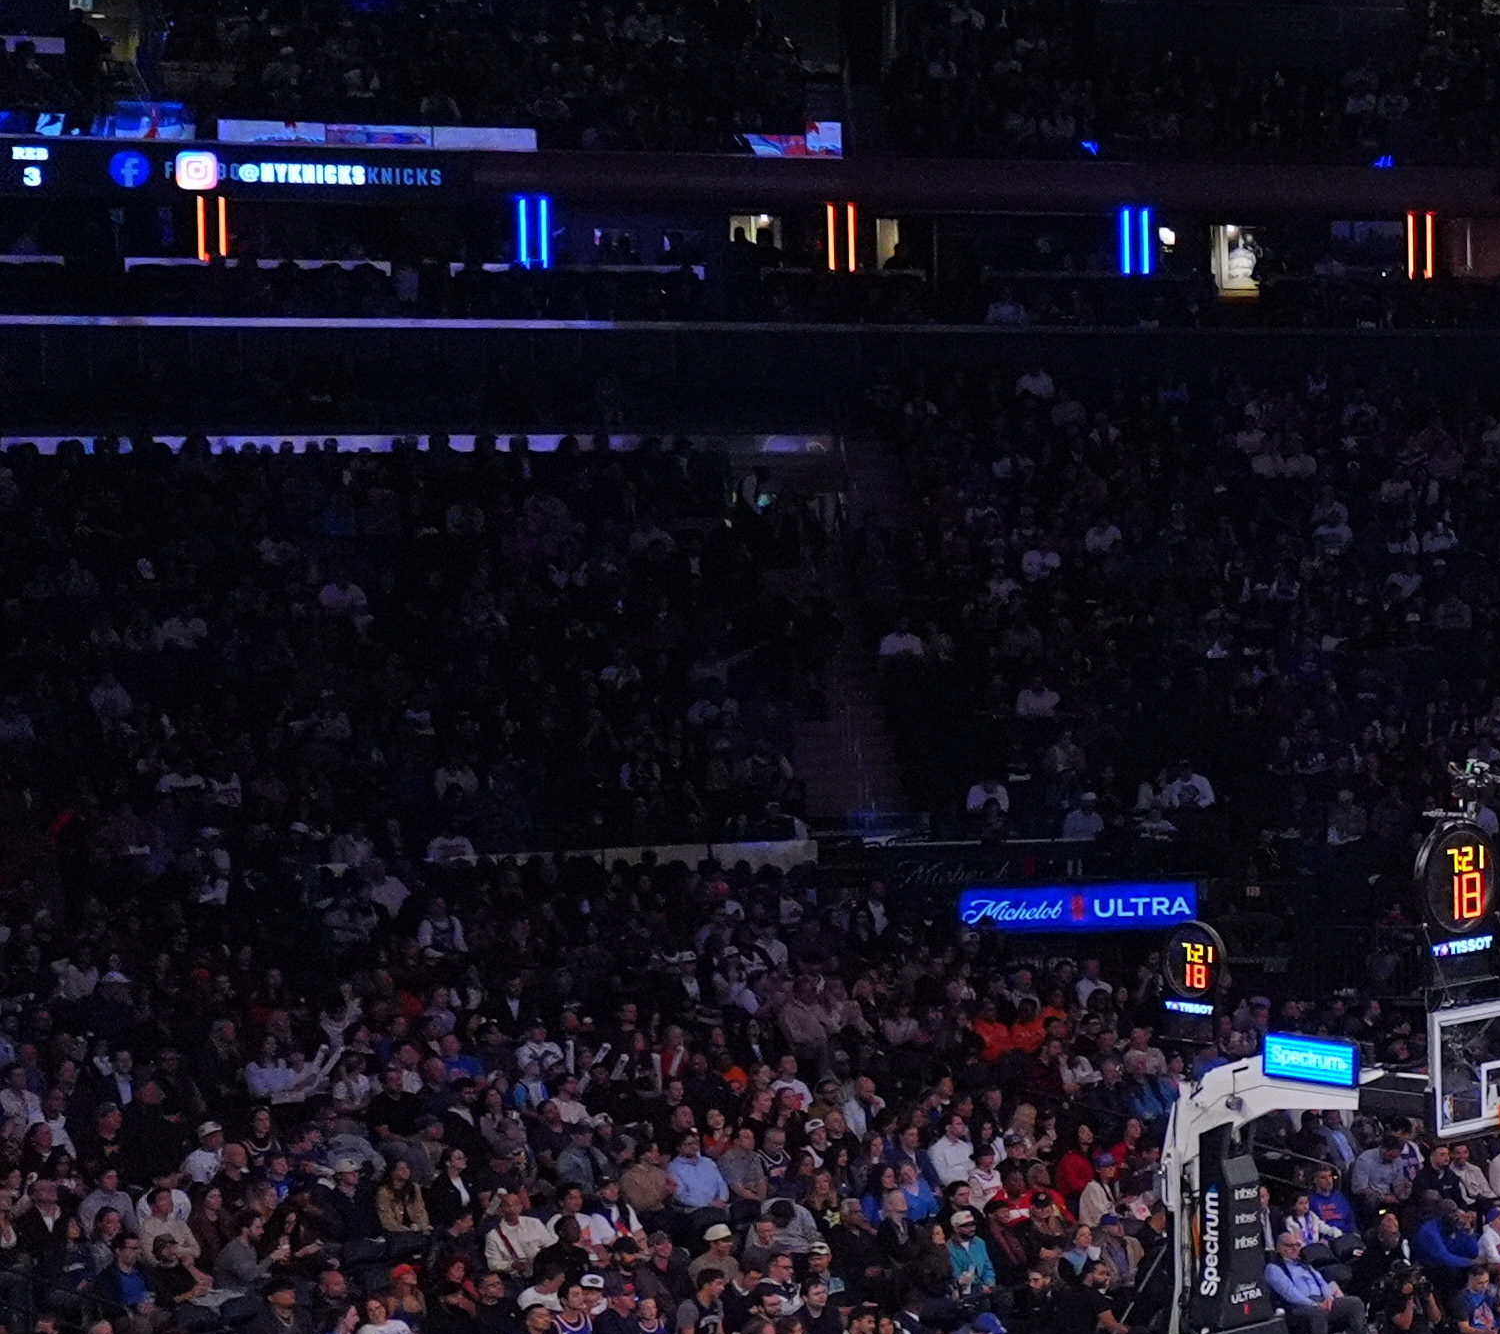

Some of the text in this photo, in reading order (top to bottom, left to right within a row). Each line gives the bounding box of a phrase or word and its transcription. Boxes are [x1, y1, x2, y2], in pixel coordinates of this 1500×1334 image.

[23, 166, 42, 187] 3
[1446, 844, 1485, 874] 7:21
[961, 896, 1192, 925] Michelob ULTRA
[1452, 871, 1482, 921] 18
[1181, 941, 1213, 964] 7:21
[1185, 963, 1207, 989] 18
[1199, 1192, 1221, 1297] Spectrum
